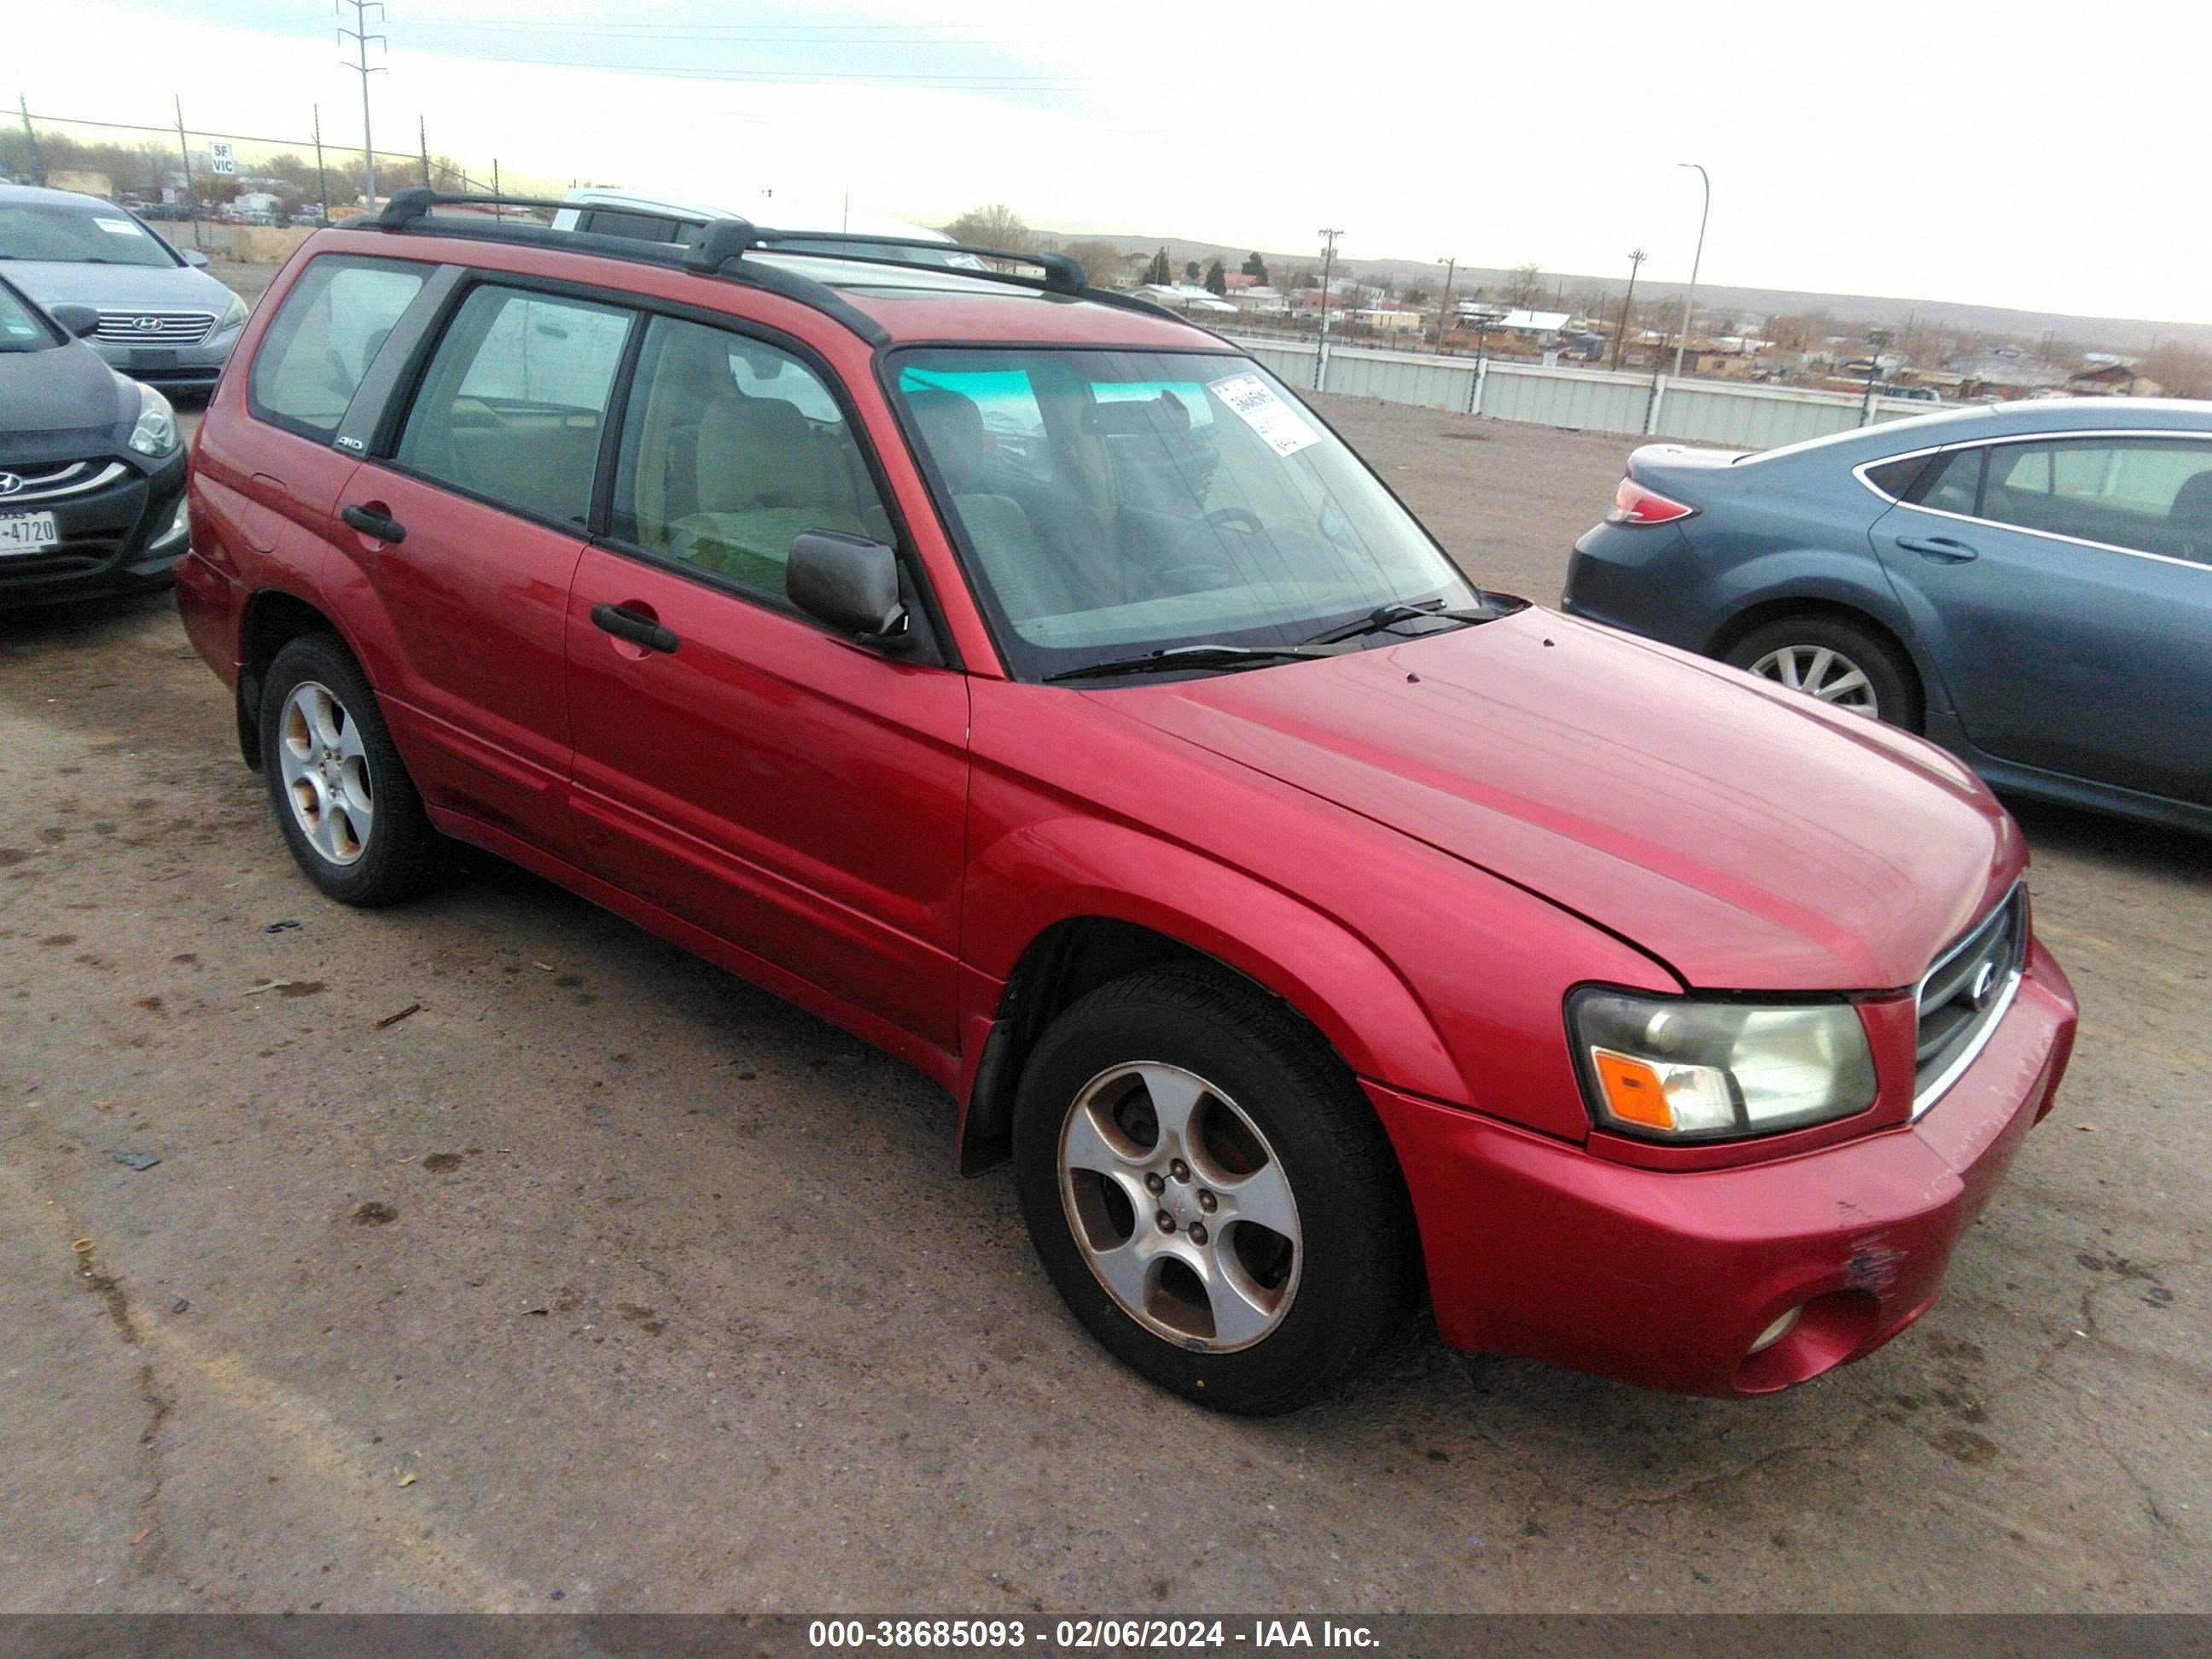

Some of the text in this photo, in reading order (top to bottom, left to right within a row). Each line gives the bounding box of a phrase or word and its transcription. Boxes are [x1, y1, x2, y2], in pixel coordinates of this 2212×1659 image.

[214, 145, 227, 156] SF
[213, 160, 232, 172] VIC
[338, 436, 363, 450] AWD
